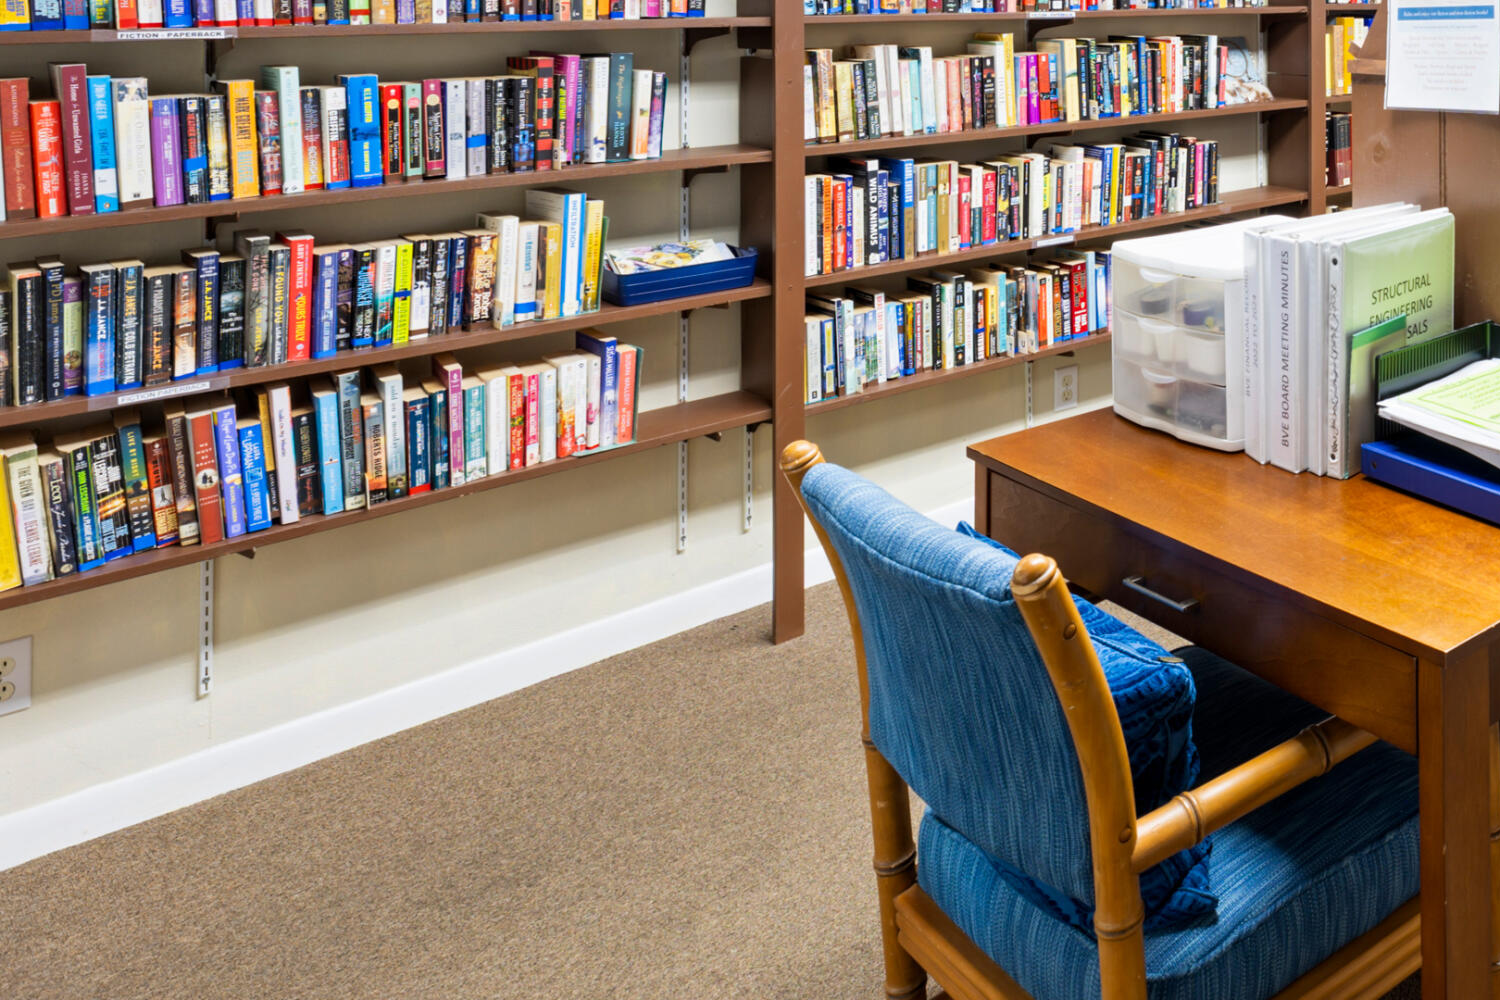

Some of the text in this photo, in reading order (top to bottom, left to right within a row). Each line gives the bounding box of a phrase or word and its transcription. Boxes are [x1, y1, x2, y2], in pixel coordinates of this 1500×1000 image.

[70, 84, 78, 102] Home
[330, 110, 338, 141] GRIFFIN
[569, 200, 578, 248] INFILTRATION
[869, 178, 878, 246] WILD ANIMUS
[274, 271, 283, 303] FOUND
[1371, 273, 1432, 305] STRUCTURAL
[49, 299, 62, 324] James
[126, 295, 136, 317] JANCE
[204, 295, 212, 321] JANCE
[274, 306, 283, 324] YOU
[472, 292, 482, 320] Jordan
[481, 292, 491, 319] Robert
[97, 314, 106, 340] JANCE
[124, 331, 135, 349] COLD
[254, 325, 262, 352] JEWELL
[295, 320, 306, 342] TRULY
[1280, 250, 1289, 447] BVE BOARD MEETING MINUTES
[371, 424, 383, 479] ROBERTS RIDGE
[50, 478, 64, 504] Leon
